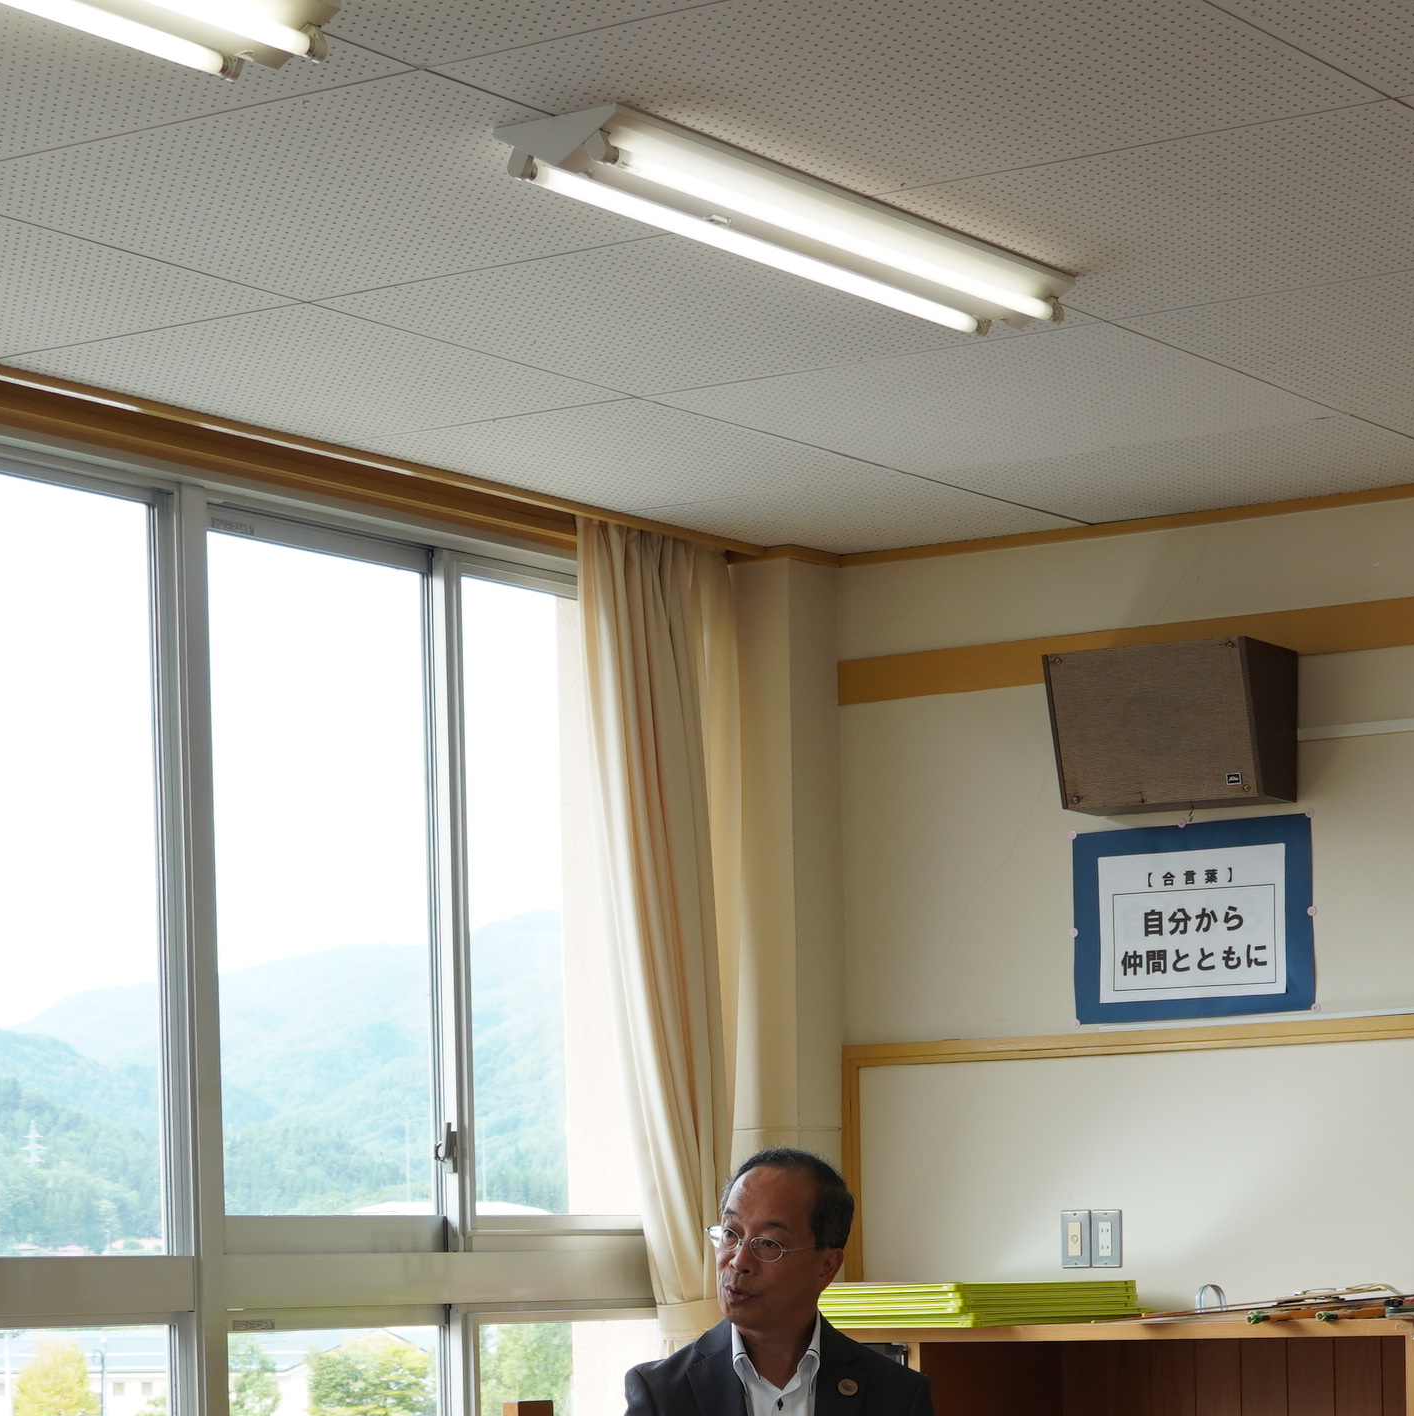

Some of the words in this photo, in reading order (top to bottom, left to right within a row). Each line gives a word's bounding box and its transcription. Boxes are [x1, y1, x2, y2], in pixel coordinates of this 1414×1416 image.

[1143, 905, 1244, 937] 自分から
[1120, 943, 1268, 977] 仲間とともに
